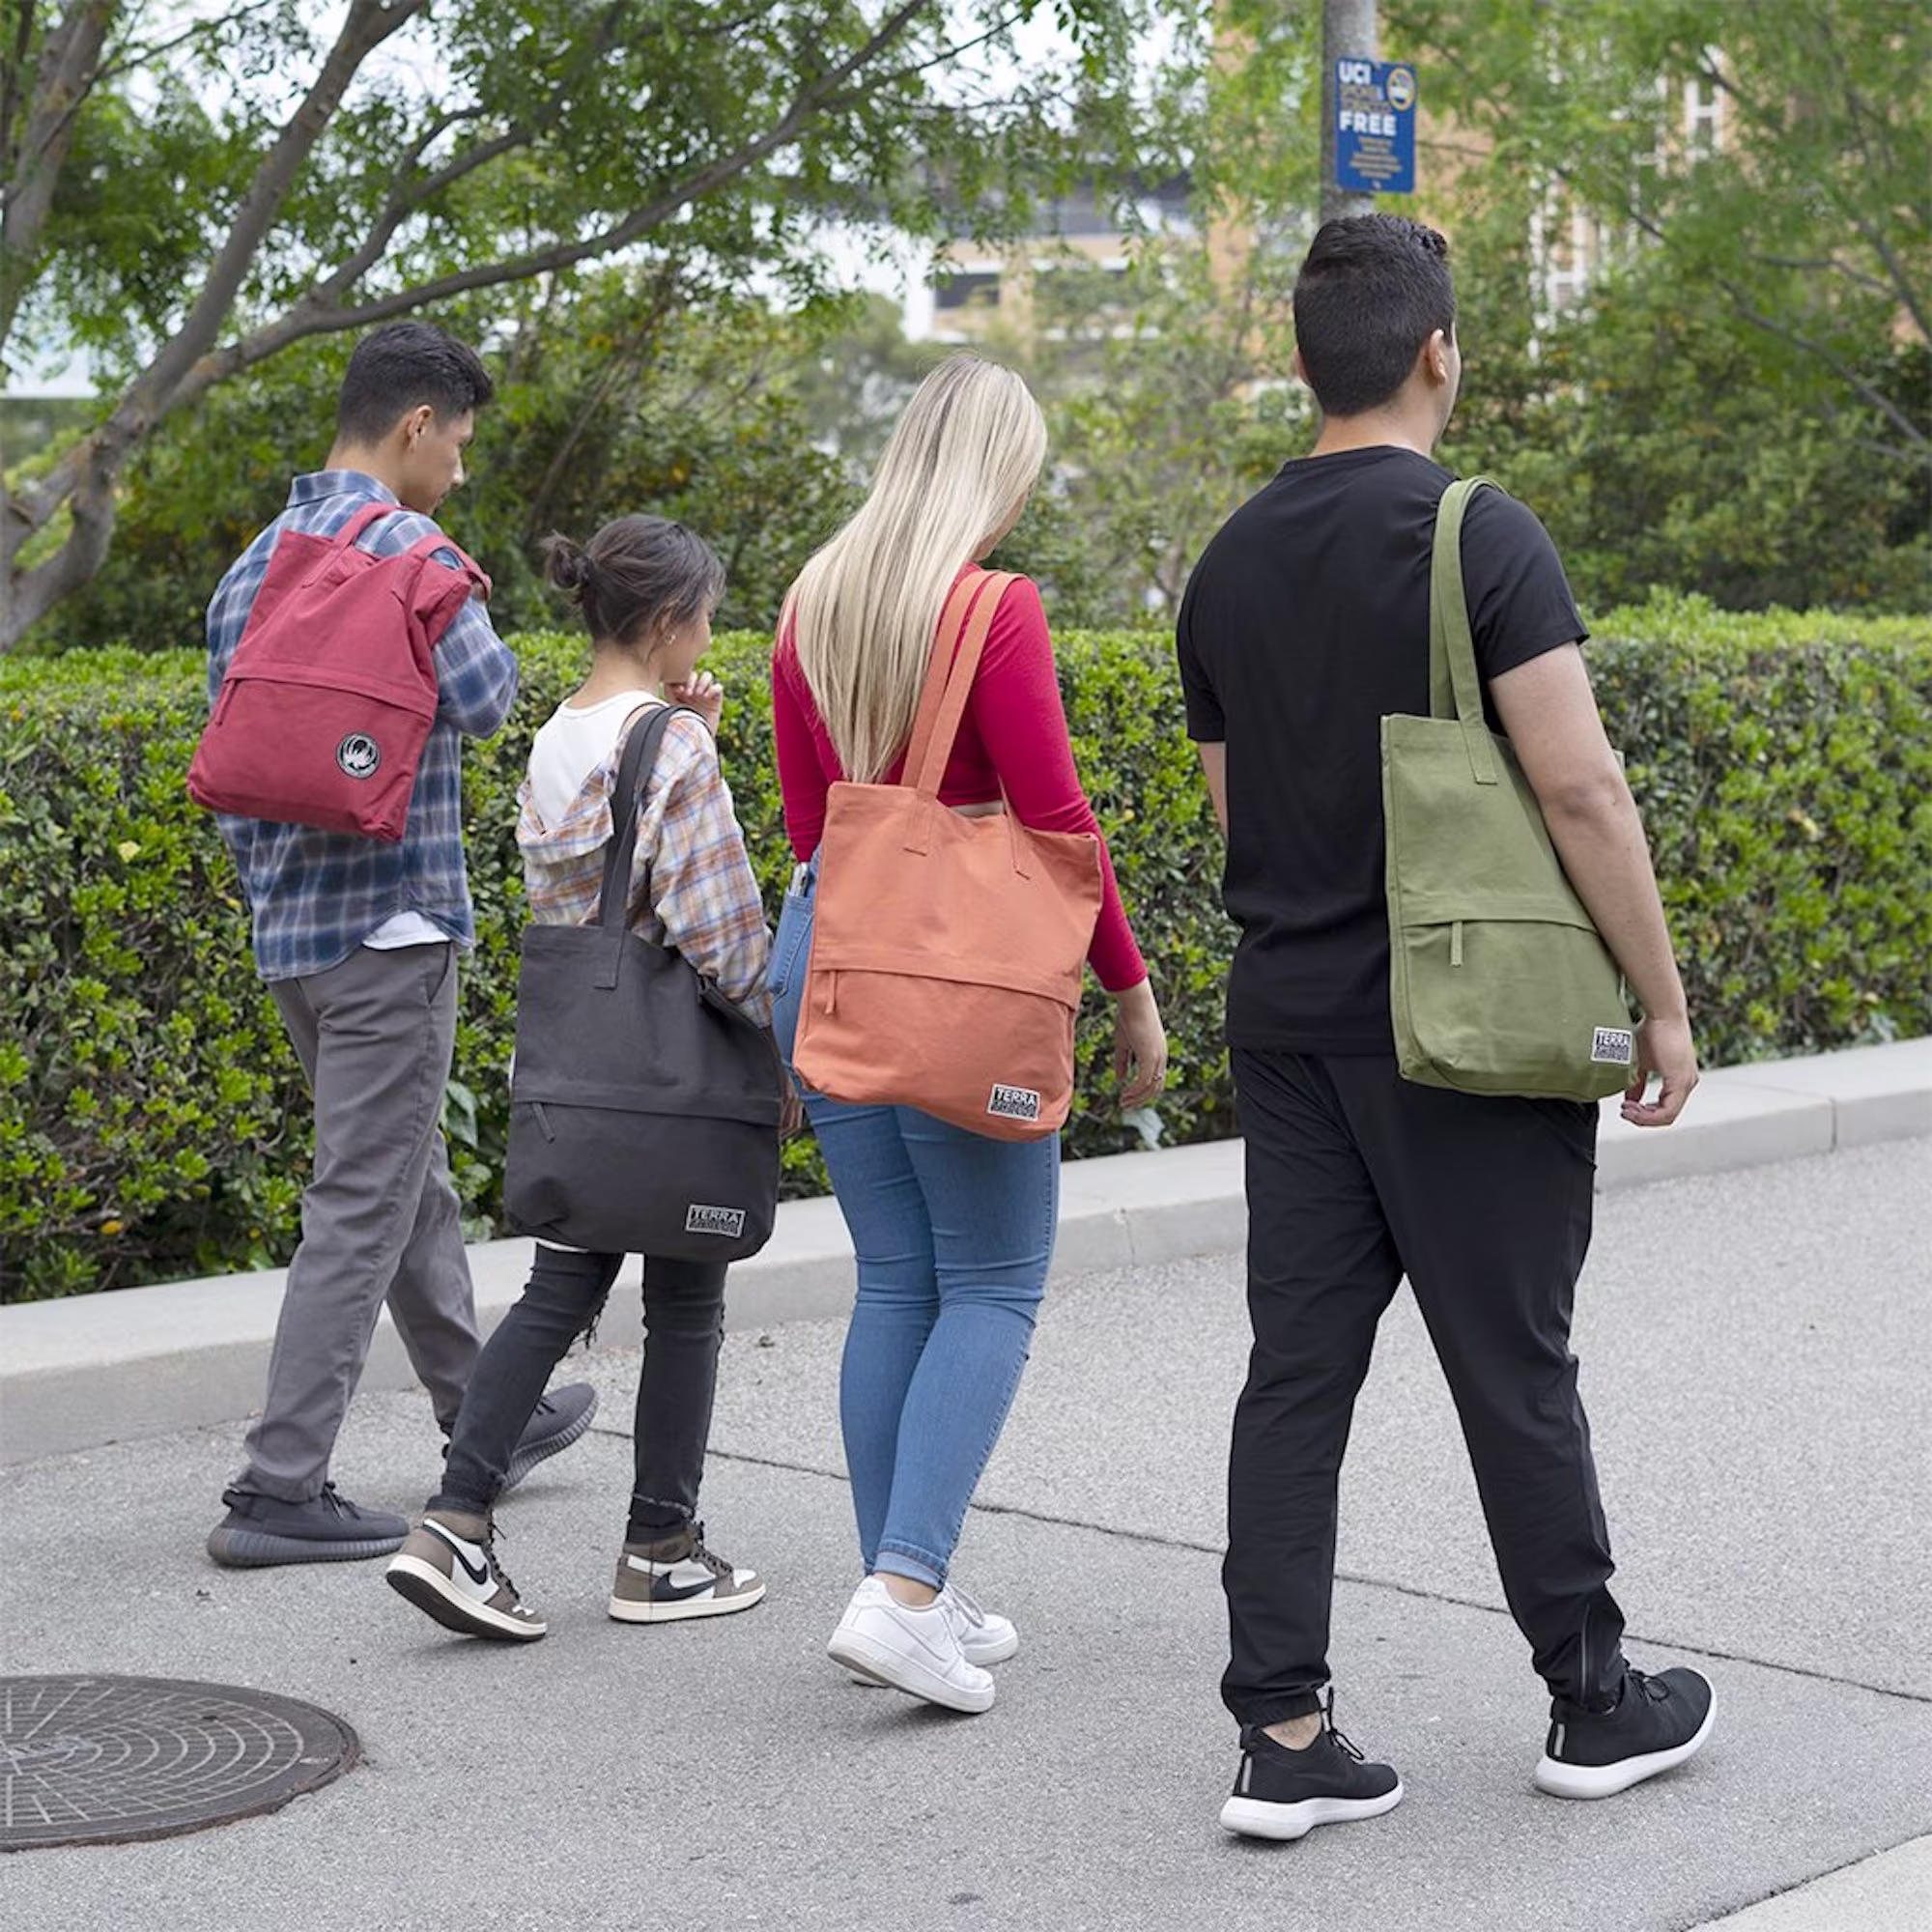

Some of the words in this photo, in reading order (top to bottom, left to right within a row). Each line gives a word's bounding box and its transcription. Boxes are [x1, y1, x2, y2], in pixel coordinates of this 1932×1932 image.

[1339, 61, 1371, 85] UCI
[1339, 111, 1397, 136] FREE
[996, 1088, 1036, 1106] TERRA
[693, 1208, 739, 1224] TERRA
